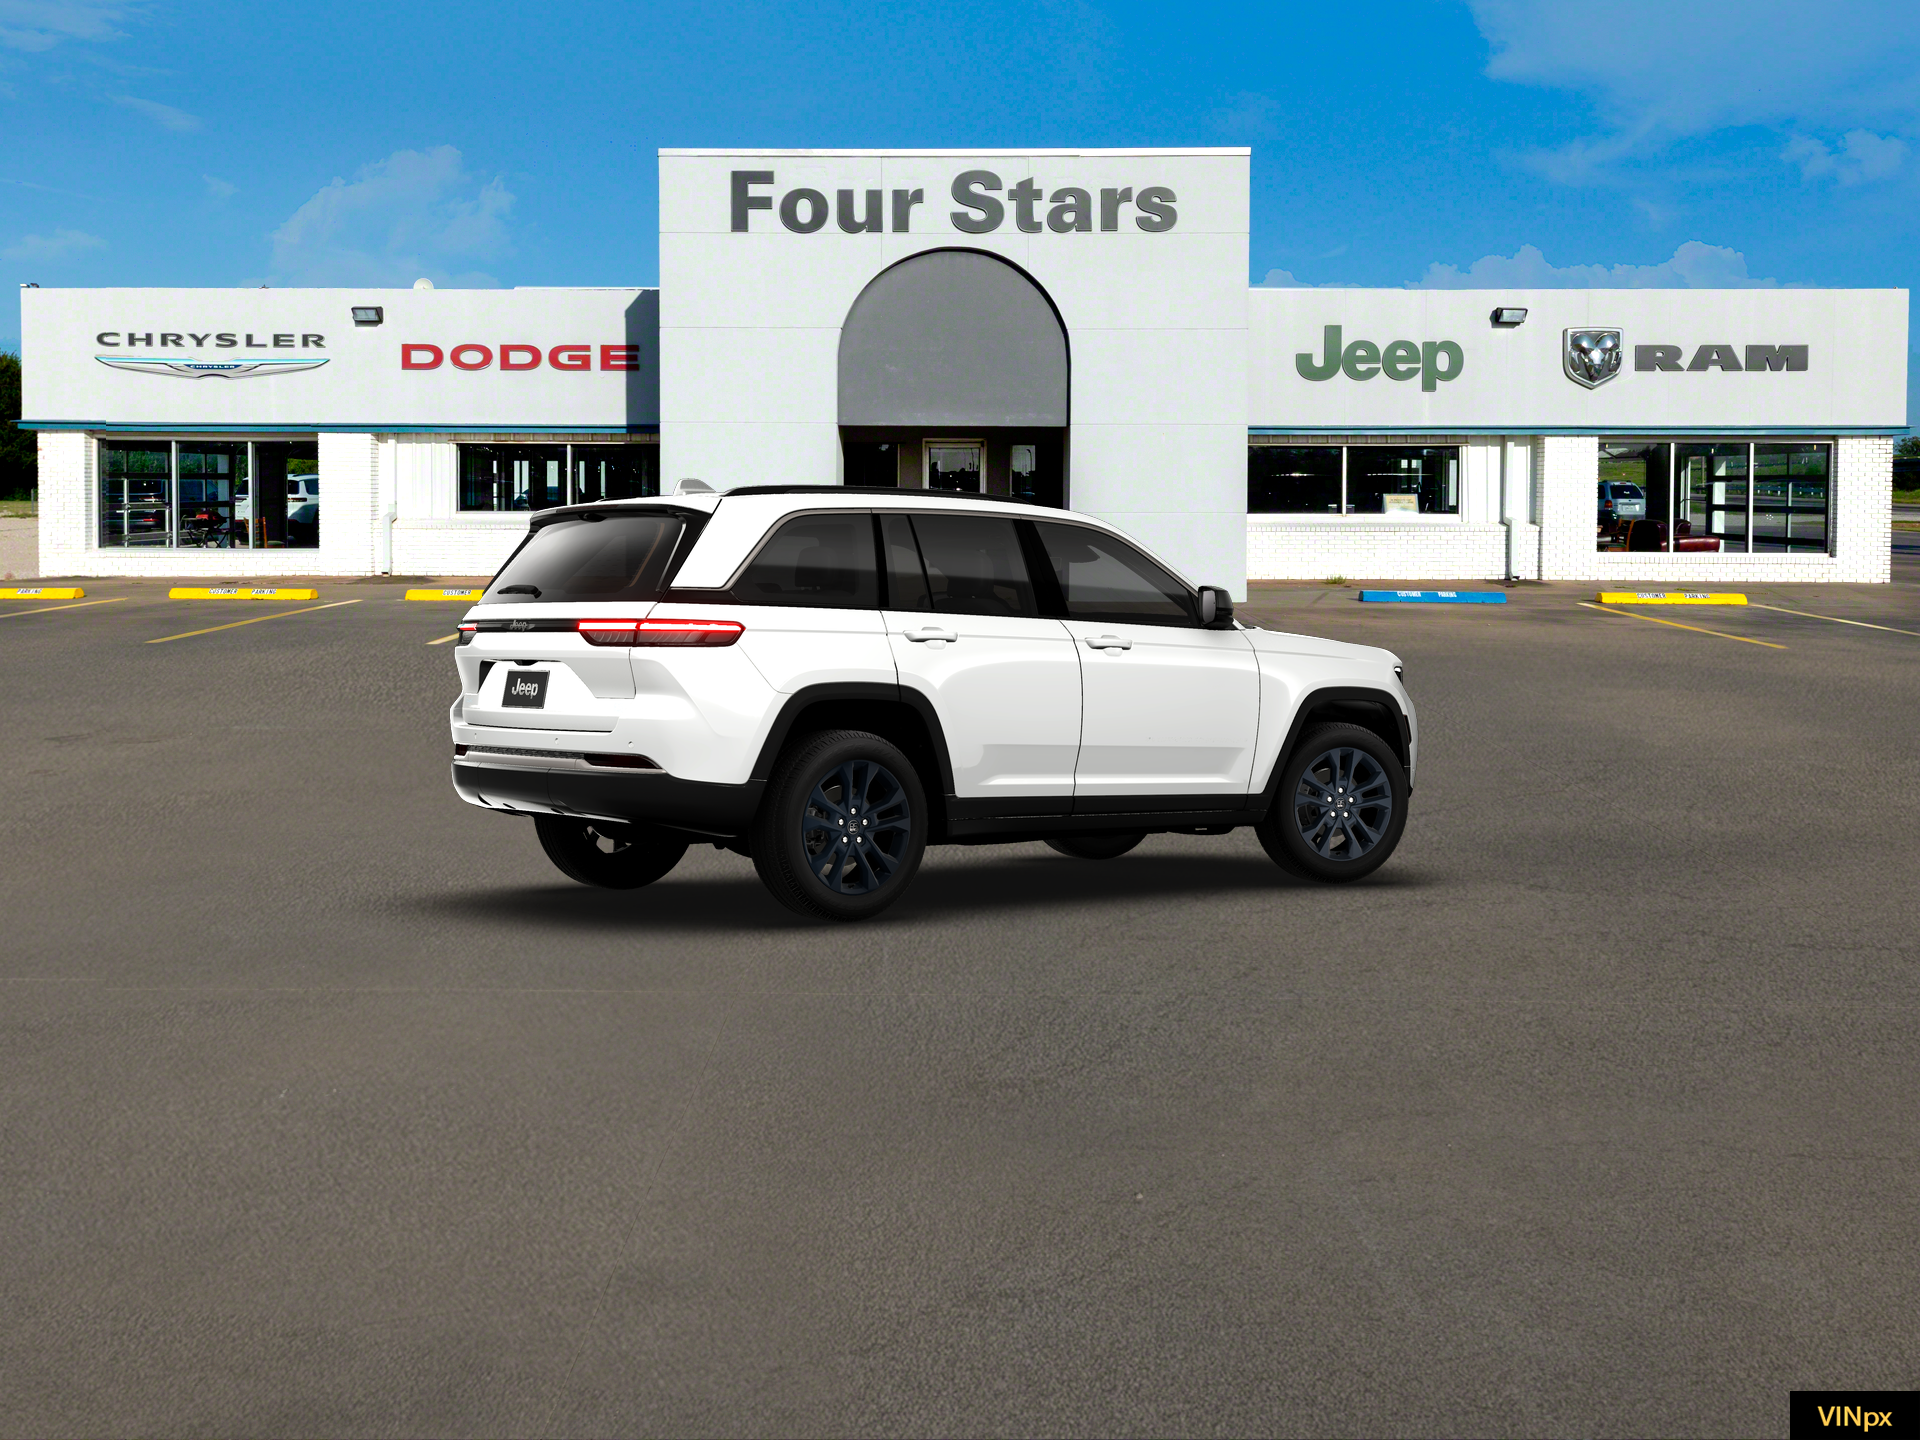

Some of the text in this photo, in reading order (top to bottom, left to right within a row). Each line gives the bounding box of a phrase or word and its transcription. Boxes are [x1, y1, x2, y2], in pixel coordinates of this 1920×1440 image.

[731, 169, 1178, 234] Four Stars
[96, 332, 327, 349] CHRYSLER
[401, 343, 640, 371] DODGE
[1296, 325, 1464, 392] Jeep
[1635, 344, 1809, 372] RAM
[510, 619, 528, 632] Jeep
[511, 677, 539, 700] Jeep
